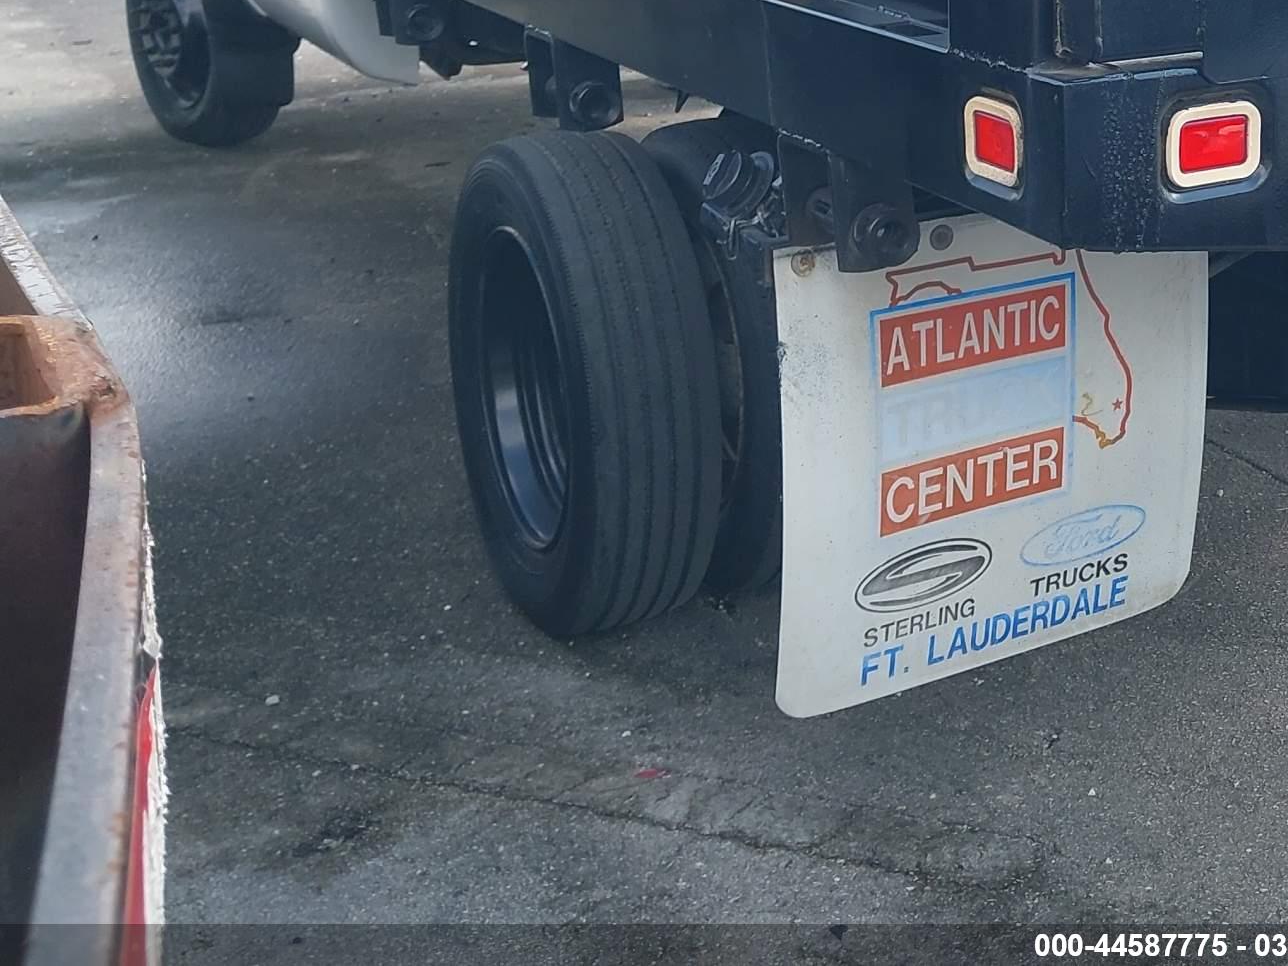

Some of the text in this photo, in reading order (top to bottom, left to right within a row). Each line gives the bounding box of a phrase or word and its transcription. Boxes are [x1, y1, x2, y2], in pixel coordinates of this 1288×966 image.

[886, 294, 1062, 376] ATLANTIC
[885, 438, 1058, 524] CENTER
[859, 575, 1129, 687] FT. LAUDERDALE
[863, 553, 1129, 648] STERLING TRUCKS
